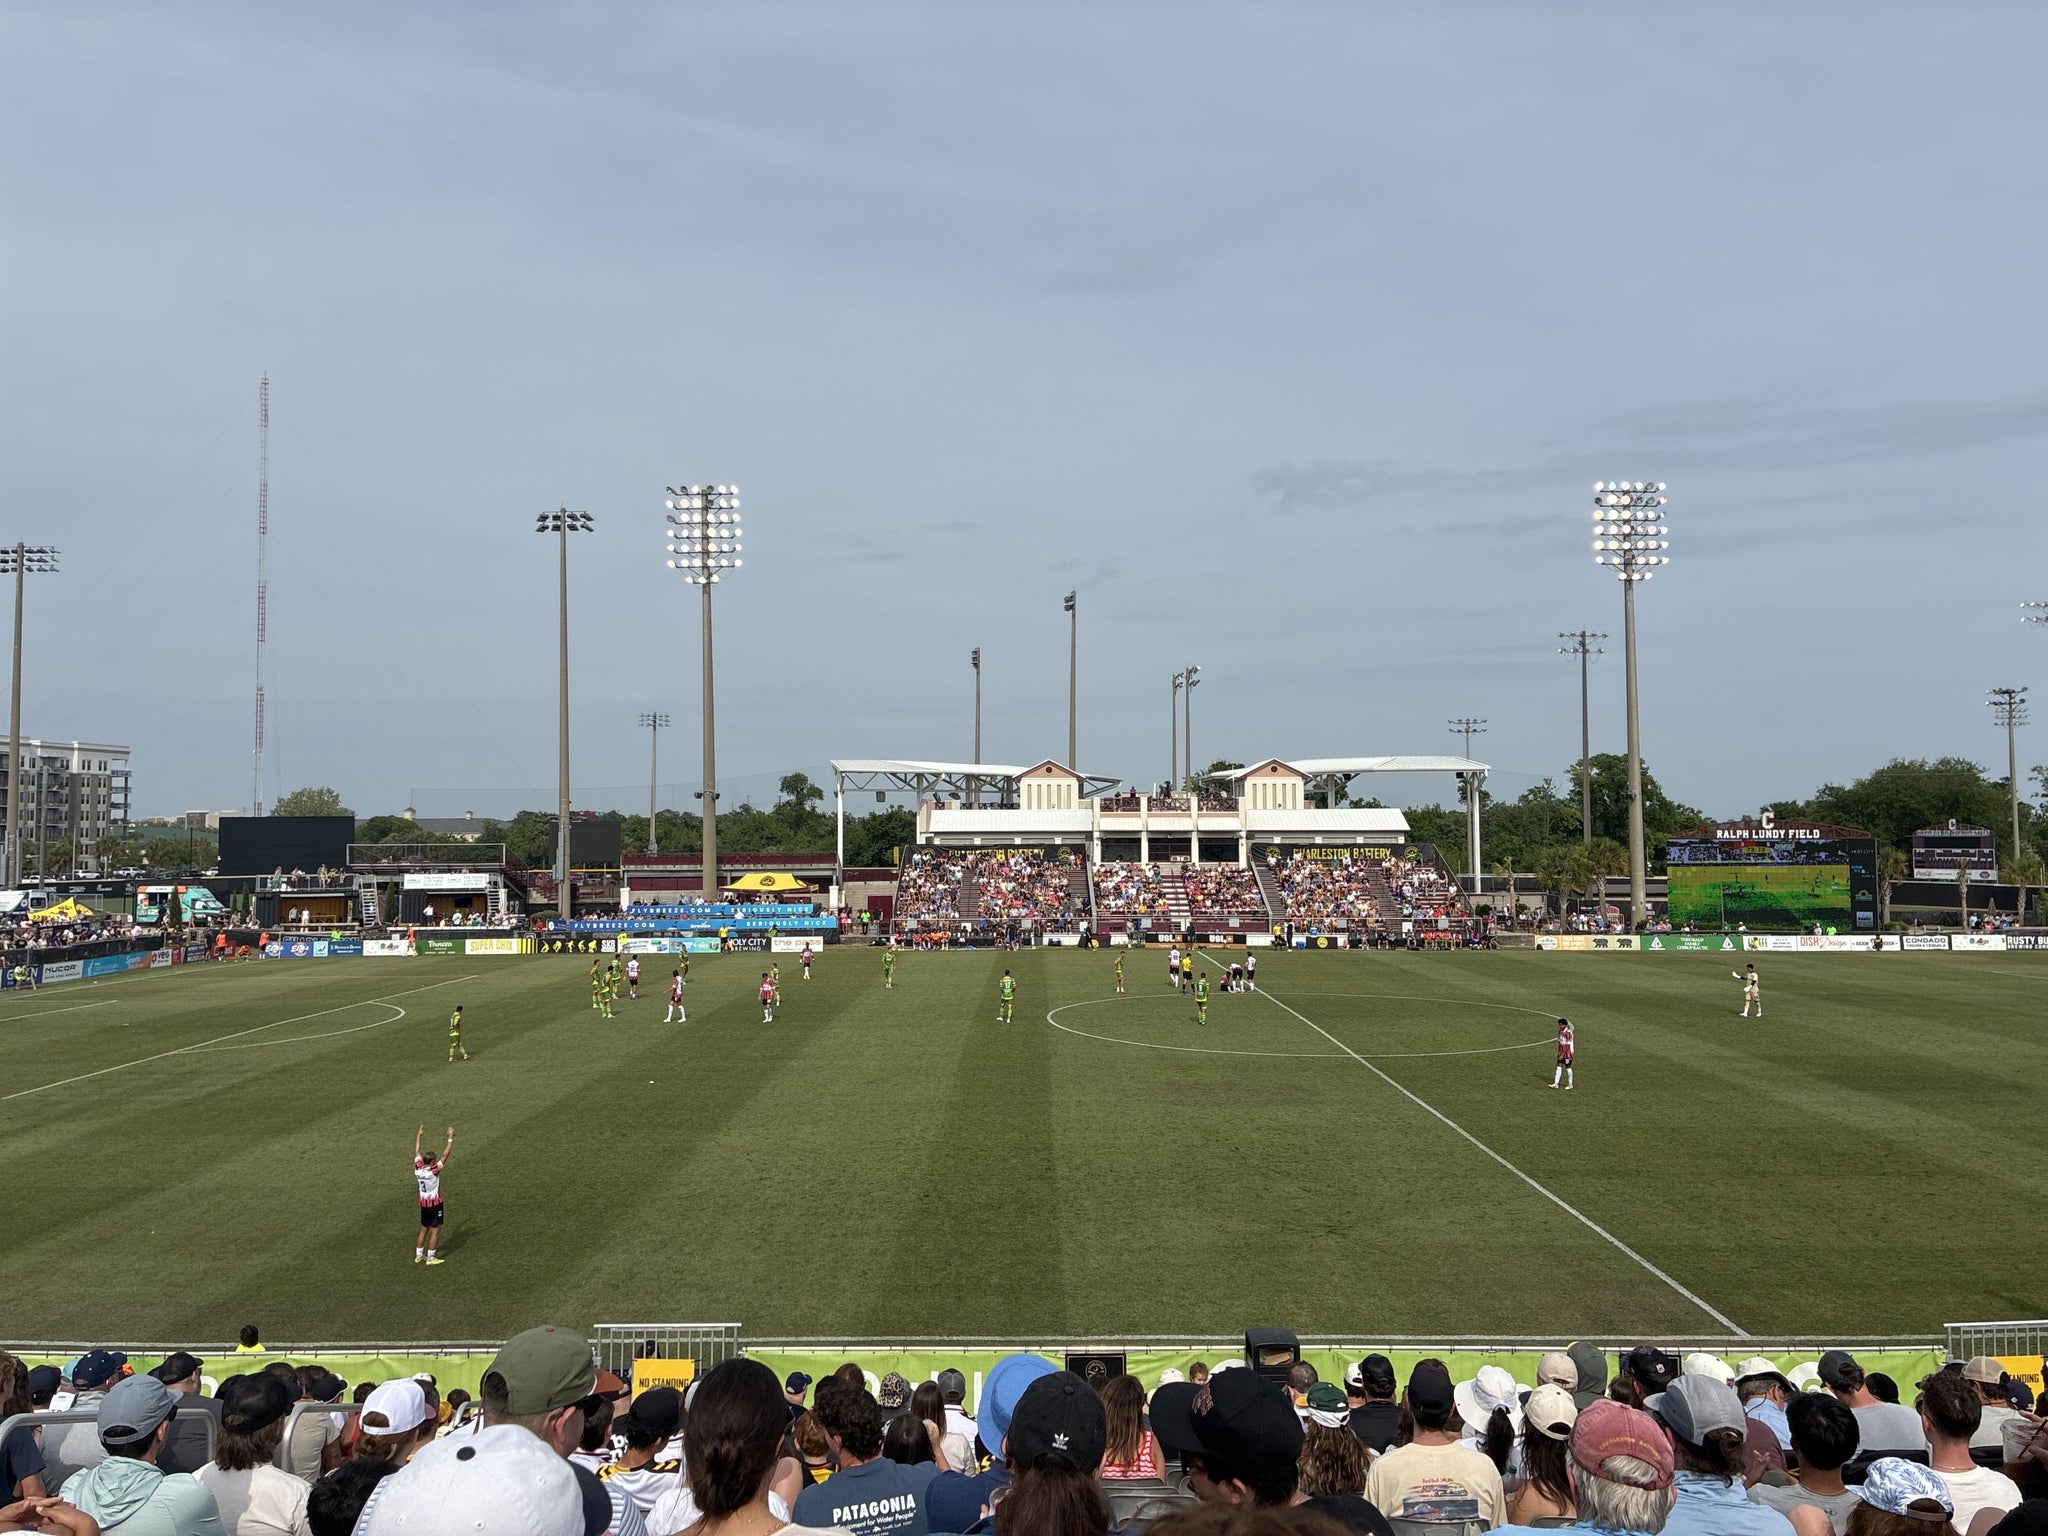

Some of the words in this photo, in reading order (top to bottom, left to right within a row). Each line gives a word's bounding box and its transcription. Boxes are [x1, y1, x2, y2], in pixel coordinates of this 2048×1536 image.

[1762, 811, 1775, 829] C
[1716, 829, 1749, 839] RALPH
[1752, 829, 1786, 839] LUNDY
[1788, 829, 1820, 839] FIELD
[1353, 847, 1391, 860] BATTERY
[746, 920, 799, 928] SERIOUSLY
[470, 939, 494, 951] SUPER
[495, 939, 513, 951] CHIX
[747, 938, 767, 946] CITY
[774, 938, 792, 946] the
[1800, 936, 1819, 947] DISH
[2007, 935, 2035, 945] RUSTY
[45, 964, 77, 973] NUCOR
[638, 1378, 650, 1388] NO
[651, 1378, 689, 1388] STANDING
[1599, 1436, 1636, 1450] CHARLESTON
[1638, 1440, 1661, 1459] BATTERY
[832, 1493, 916, 1523] PATAGONIA
[866, 1518, 876, 1526] for
[876, 1515, 894, 1524] Water
